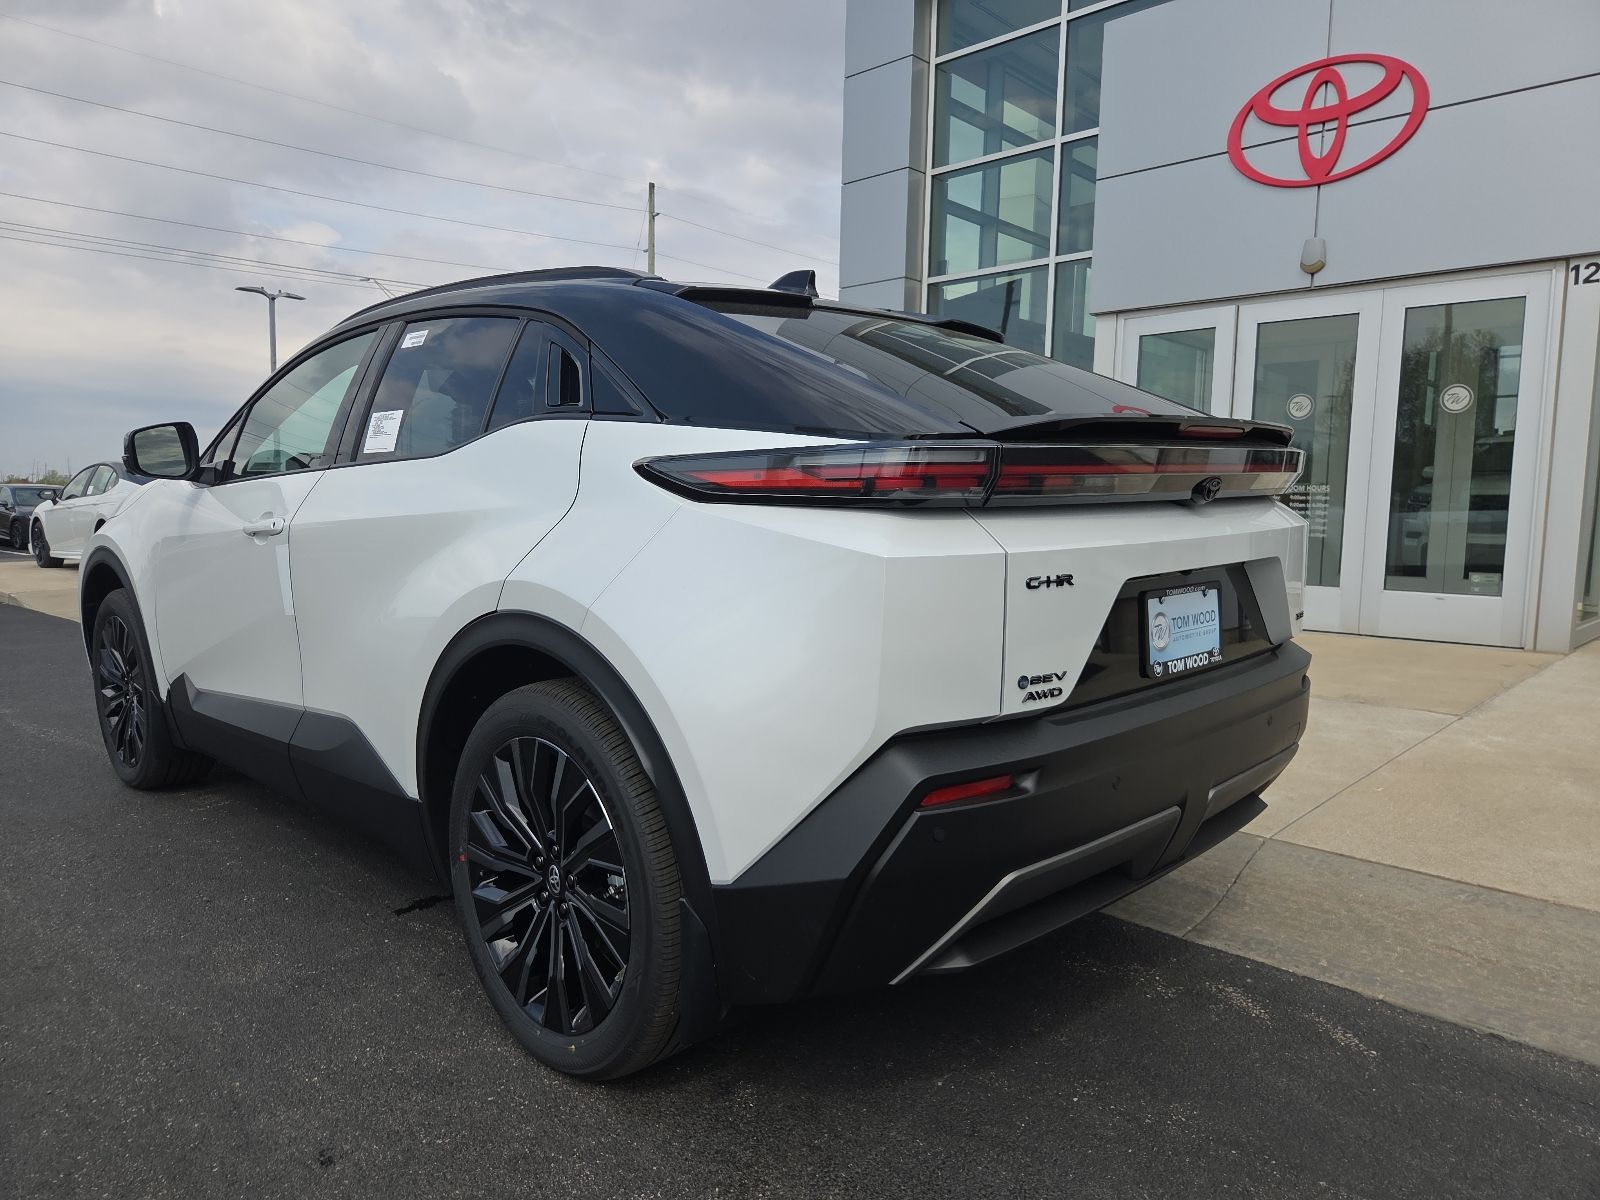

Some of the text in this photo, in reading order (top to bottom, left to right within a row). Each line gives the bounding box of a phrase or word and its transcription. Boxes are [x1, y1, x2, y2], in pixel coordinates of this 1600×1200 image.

[1570, 262, 1600, 286] 12
[1306, 485, 1330, 493] HOURS
[1166, 585, 1206, 596] TOMWOOD.com
[1171, 609, 1216, 631] TOM WOOD
[1167, 658, 1185, 674] TOM
[1185, 652, 1209, 670] WOOD
[1021, 686, 1063, 704] AWD
